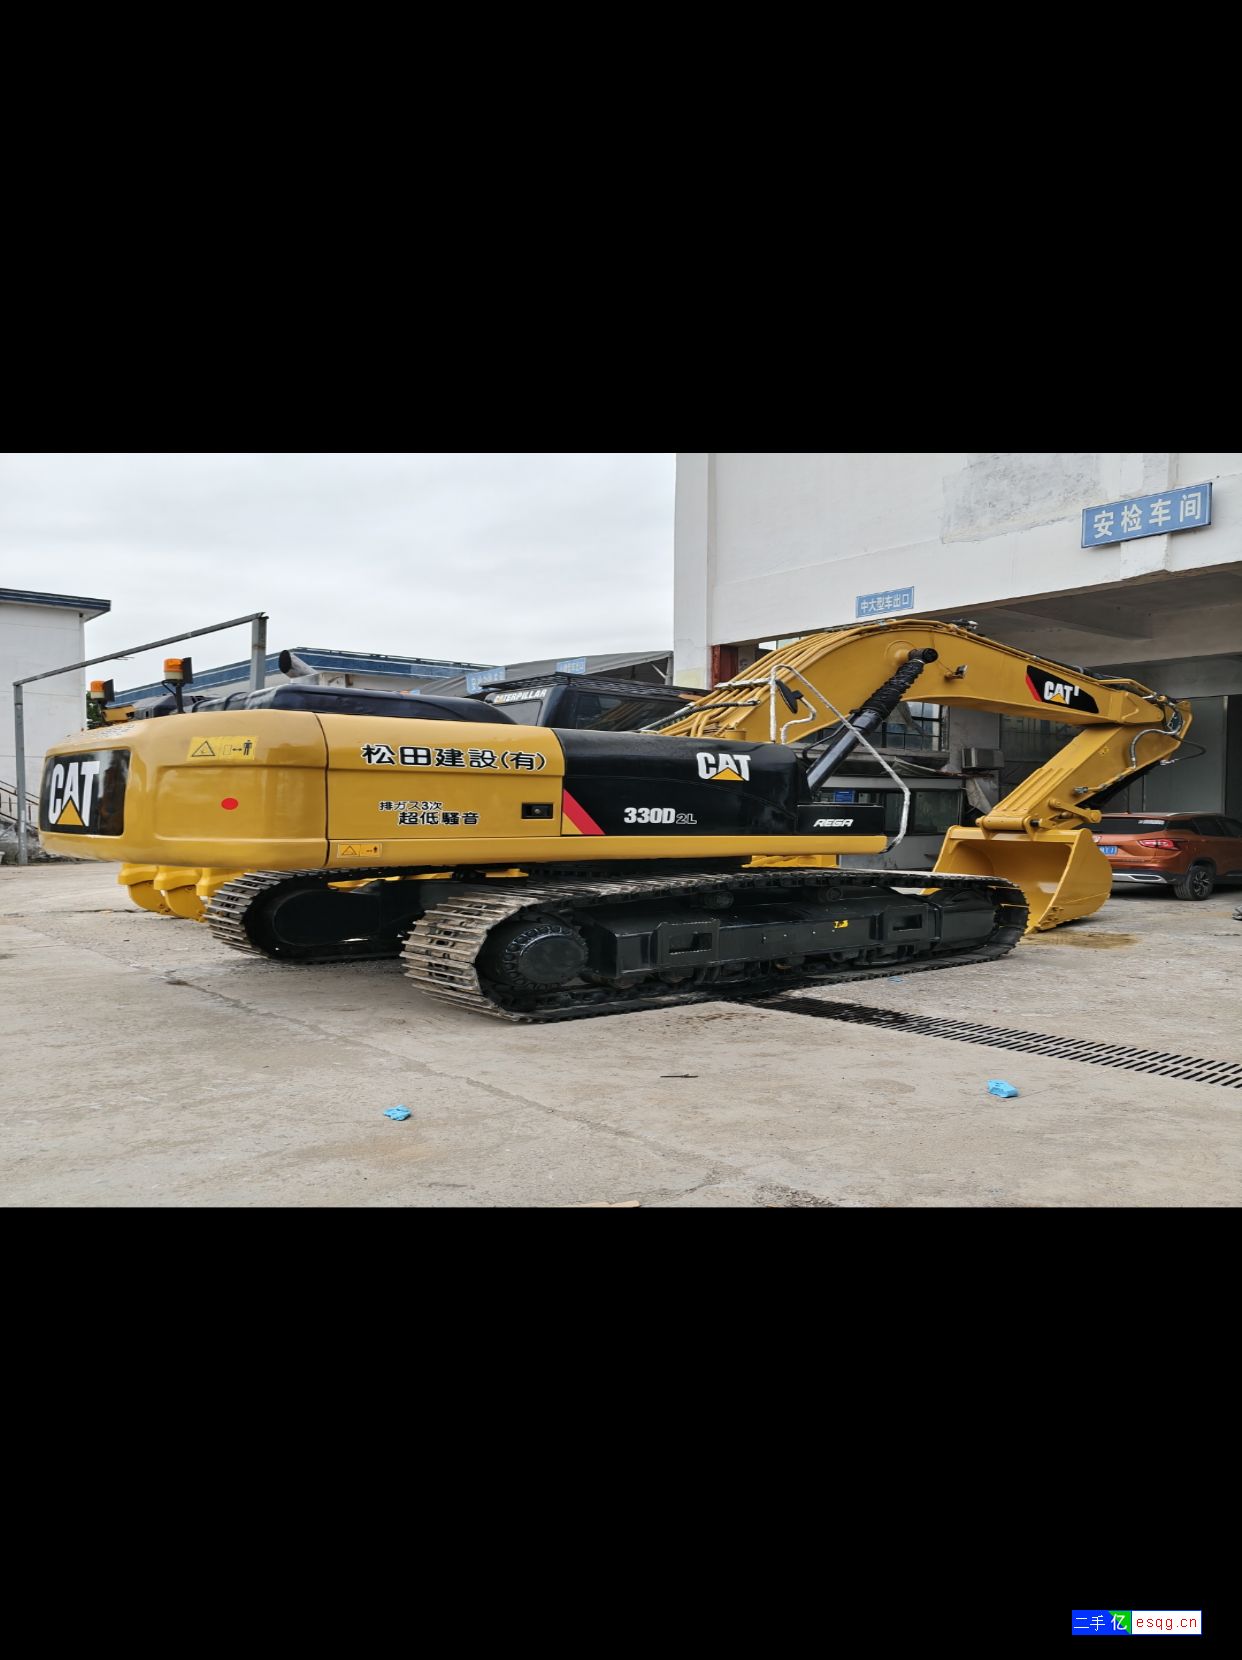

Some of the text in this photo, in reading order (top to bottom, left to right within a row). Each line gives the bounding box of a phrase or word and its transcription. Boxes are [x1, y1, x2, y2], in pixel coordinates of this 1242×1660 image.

[1093, 492, 1201, 539] 安检车间
[860, 594, 909, 613] 中大型车出口
[1044, 681, 1073, 705] CAT
[361, 744, 546, 771] 松田建設(有)
[697, 752, 751, 782] CAT
[48, 761, 100, 827] CAT
[380, 801, 442, 811] 排ガス3次
[398, 811, 479, 825] 超低騒音
